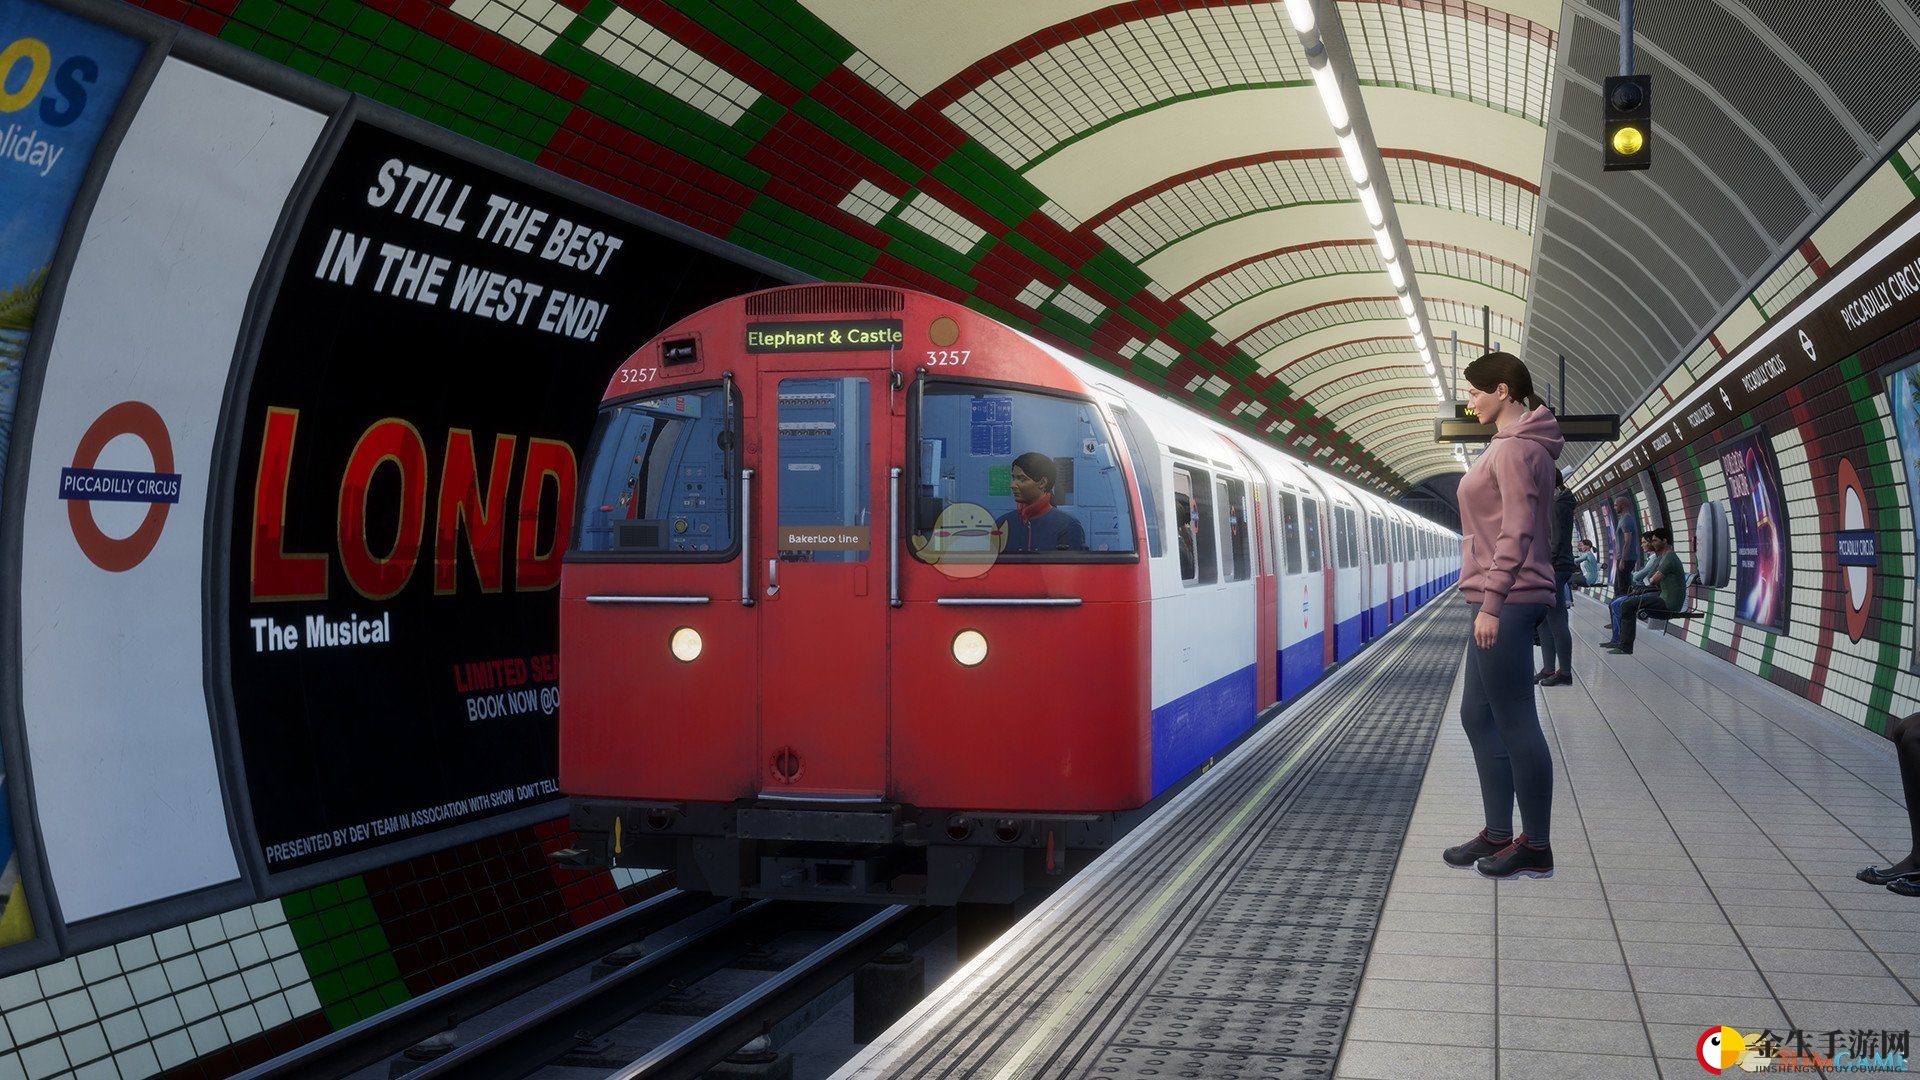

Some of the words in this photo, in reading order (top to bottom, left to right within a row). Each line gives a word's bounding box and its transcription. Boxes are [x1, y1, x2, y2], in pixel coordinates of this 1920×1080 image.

[0, 123, 64, 177] liday
[367, 158, 472, 232] STILL
[477, 194, 549, 253] THE
[540, 218, 624, 275] BEST
[315, 228, 371, 286] IN
[373, 242, 452, 306] THE
[449, 264, 543, 326] WEST
[538, 290, 609, 342] END!
[1840, 282, 1893, 331] PICCADILLY
[1887, 257, 1920, 301] CIRCU
[748, 331, 825, 348] Elephant
[829, 330, 842, 343] &
[847, 328, 903, 343] Castle
[621, 368, 657, 383] 3257
[926, 351, 971, 366] 3257
[64, 475, 135, 493] PICCADILLY
[136, 479, 178, 496] CIRCUS
[788, 534, 836, 544] Bakerloo
[838, 534, 859, 544] line
[250, 617, 299, 652] The
[305, 611, 390, 648] Musical
[454, 658, 527, 693] LIMITED
[466, 694, 508, 721] BOOK
[508, 689, 538, 715] NOW
[266, 832, 332, 864] PRESENTED
[333, 828, 348, 847] BY
[349, 823, 370, 843] DEV
[371, 816, 399, 838] TEAM
[399, 814, 411, 831] IN
[411, 800, 469, 828] ASSOCIATION
[468, 794, 491, 813] WITH
[490, 788, 515, 807] SHOW
[517, 781, 540, 801] DON'T
[540, 778, 560, 794] TELL
